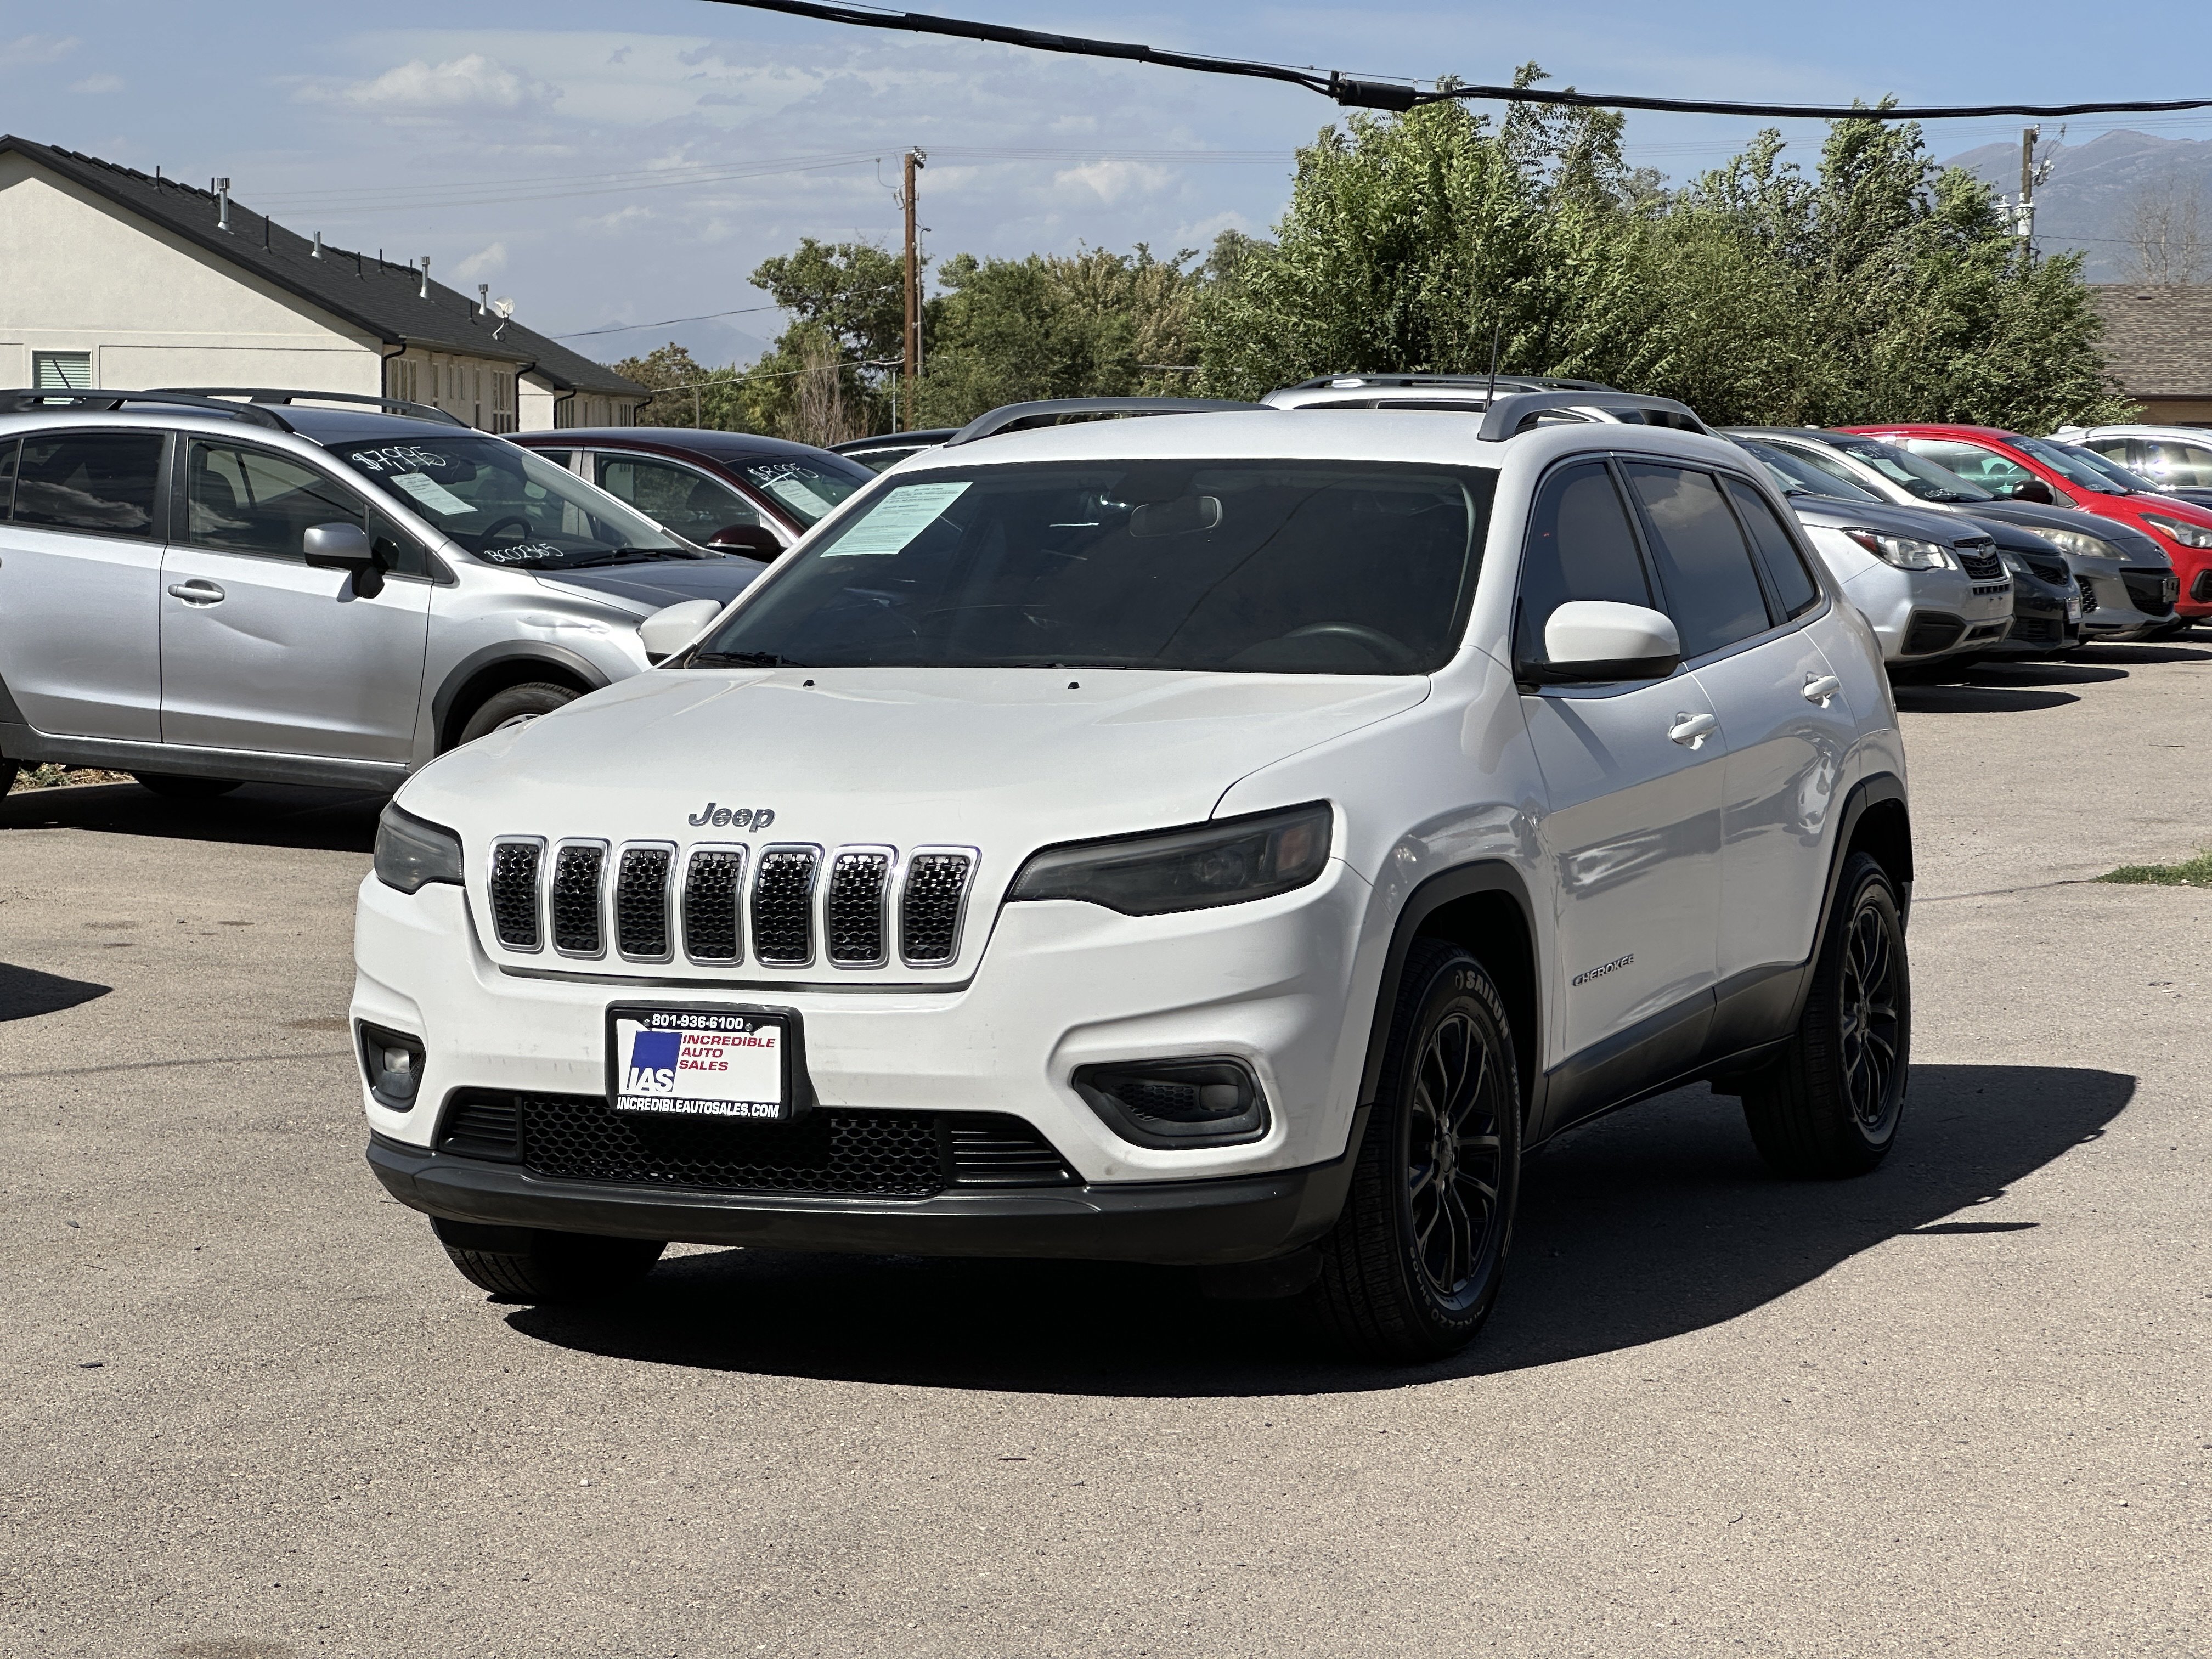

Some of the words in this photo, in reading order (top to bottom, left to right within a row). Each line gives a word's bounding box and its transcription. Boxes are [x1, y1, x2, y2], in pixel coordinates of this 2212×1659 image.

[352, 446, 447, 471] $7,995
[484, 543, 564, 562] BC02365
[688, 802, 776, 833] Jeep
[1572, 953, 1634, 986] CHEROKEE
[1465, 970, 1509, 1040] SAILUN
[652, 1014, 744, 1030] 801-936-6100
[681, 1047, 724, 1058] AUTO
[682, 1035, 776, 1048] INCREDIBLE
[679, 1060, 729, 1071] SALES
[629, 1067, 674, 1092] IAS
[617, 1096, 780, 1119] INCREDIBLEAUTOSALES.COM
